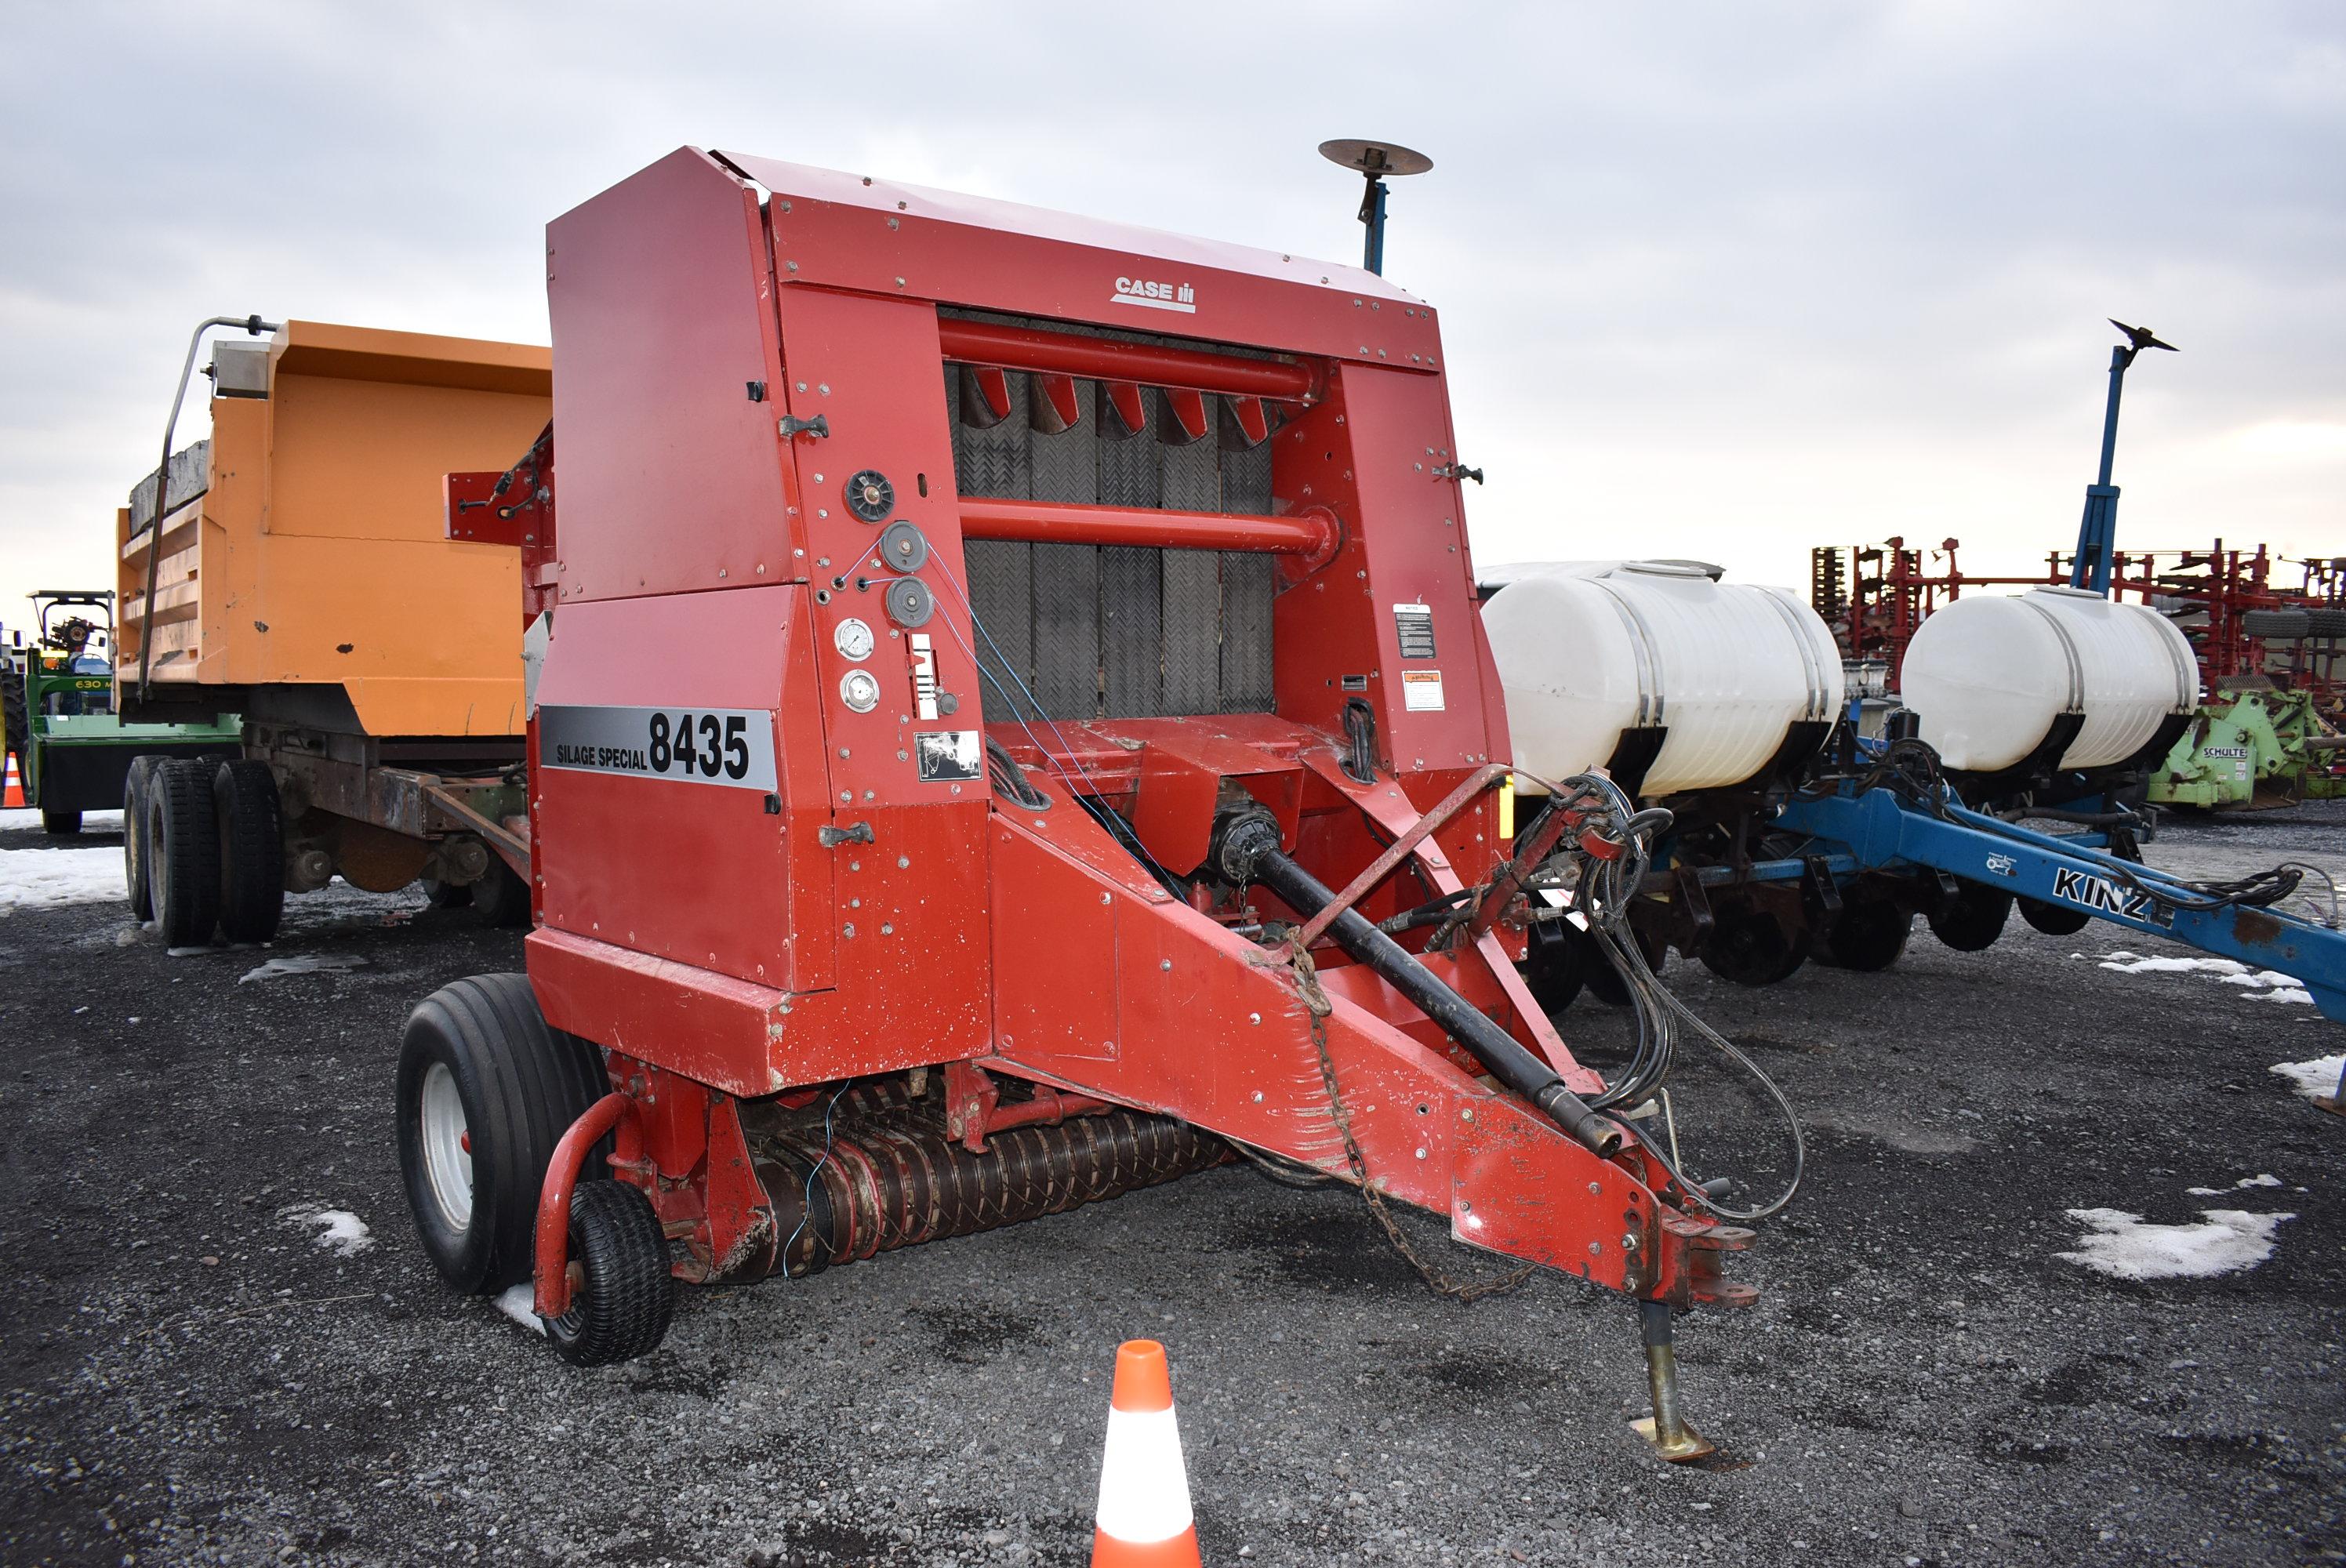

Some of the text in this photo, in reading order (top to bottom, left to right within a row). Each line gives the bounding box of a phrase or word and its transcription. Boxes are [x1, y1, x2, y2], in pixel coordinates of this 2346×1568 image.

[1115, 277, 1173, 299] CASE
[75, 680, 101, 688] 630
[557, 712, 749, 780] SILAGE SPECIAL 8435
[2203, 746, 2246, 757] SCHULTE
